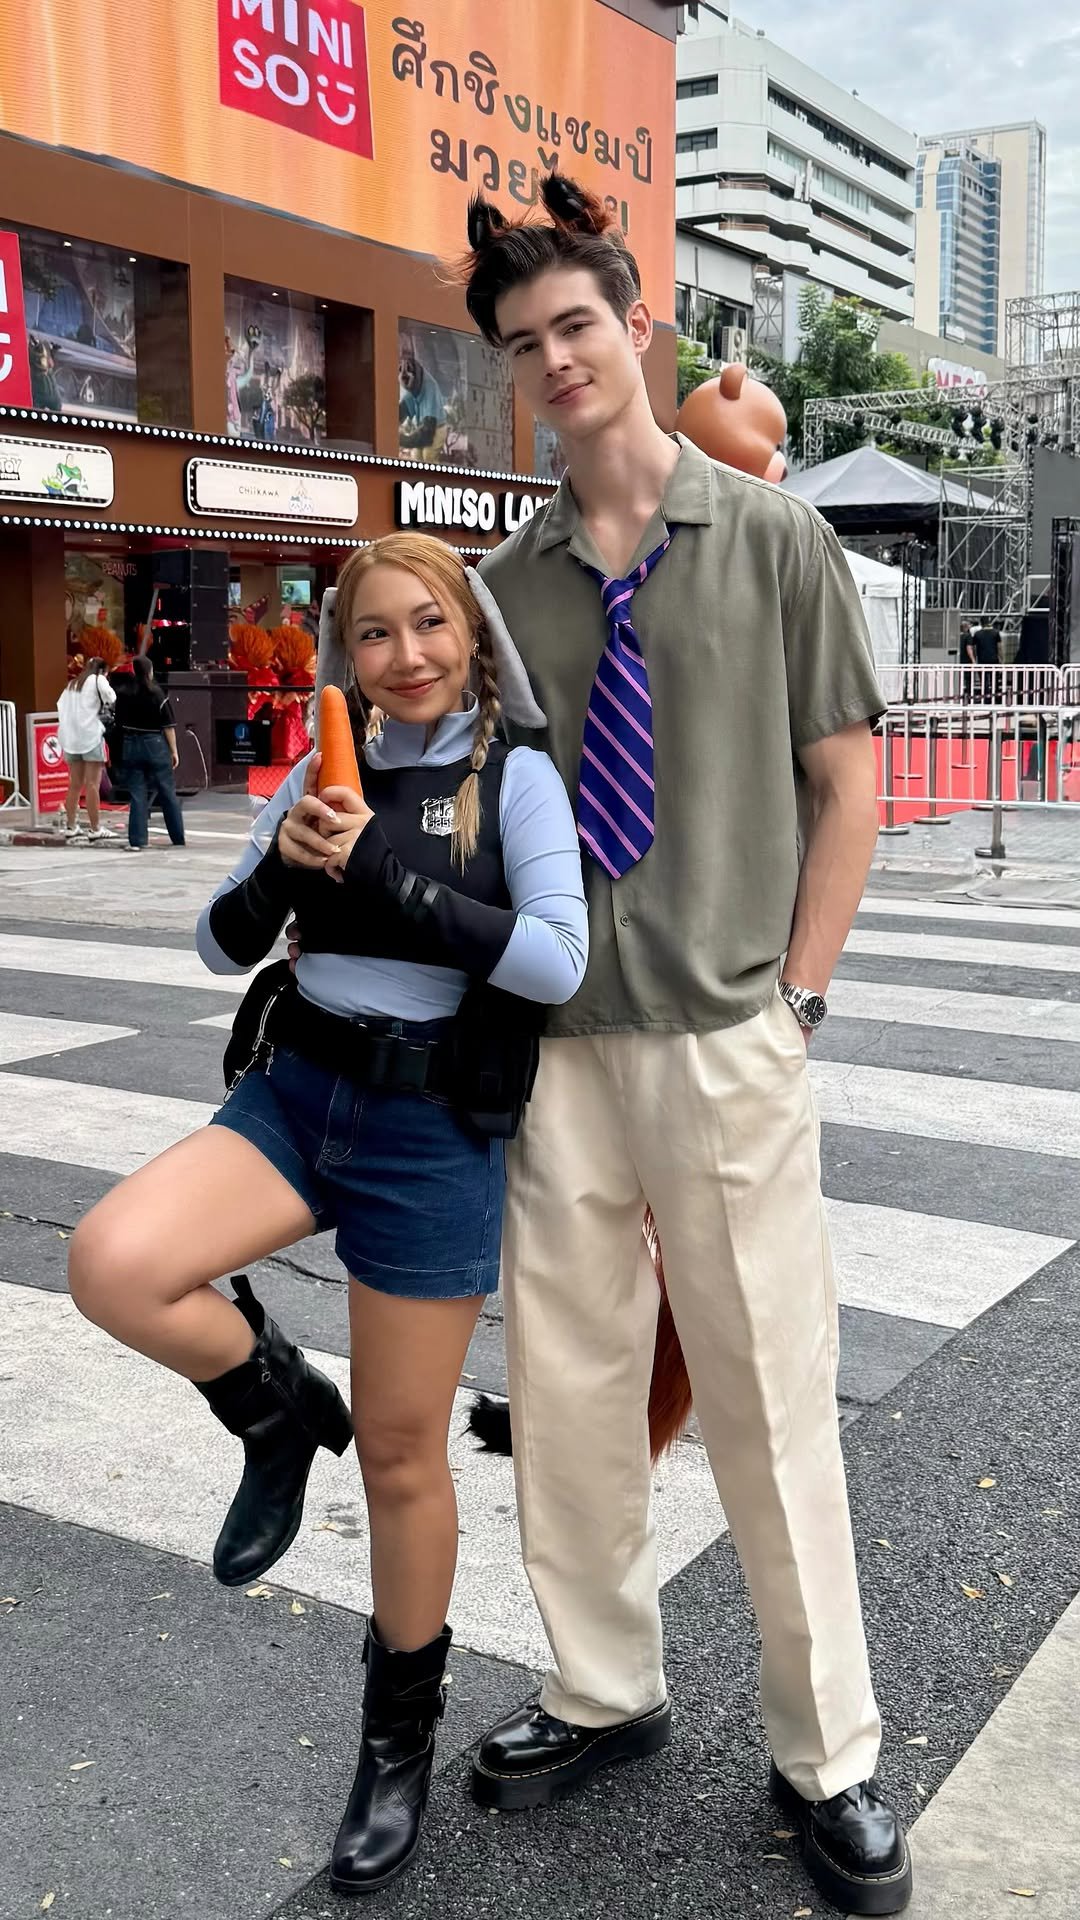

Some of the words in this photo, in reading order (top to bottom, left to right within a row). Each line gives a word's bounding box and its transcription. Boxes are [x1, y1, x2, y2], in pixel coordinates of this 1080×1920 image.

[231, 0, 353, 69] MINI
[391, 16, 652, 184] ศึกชิงแชมป์
[401, 481, 496, 531] MINISO
[504, 491, 552, 532] LA
[103, 561, 137, 577] PEANUTS
